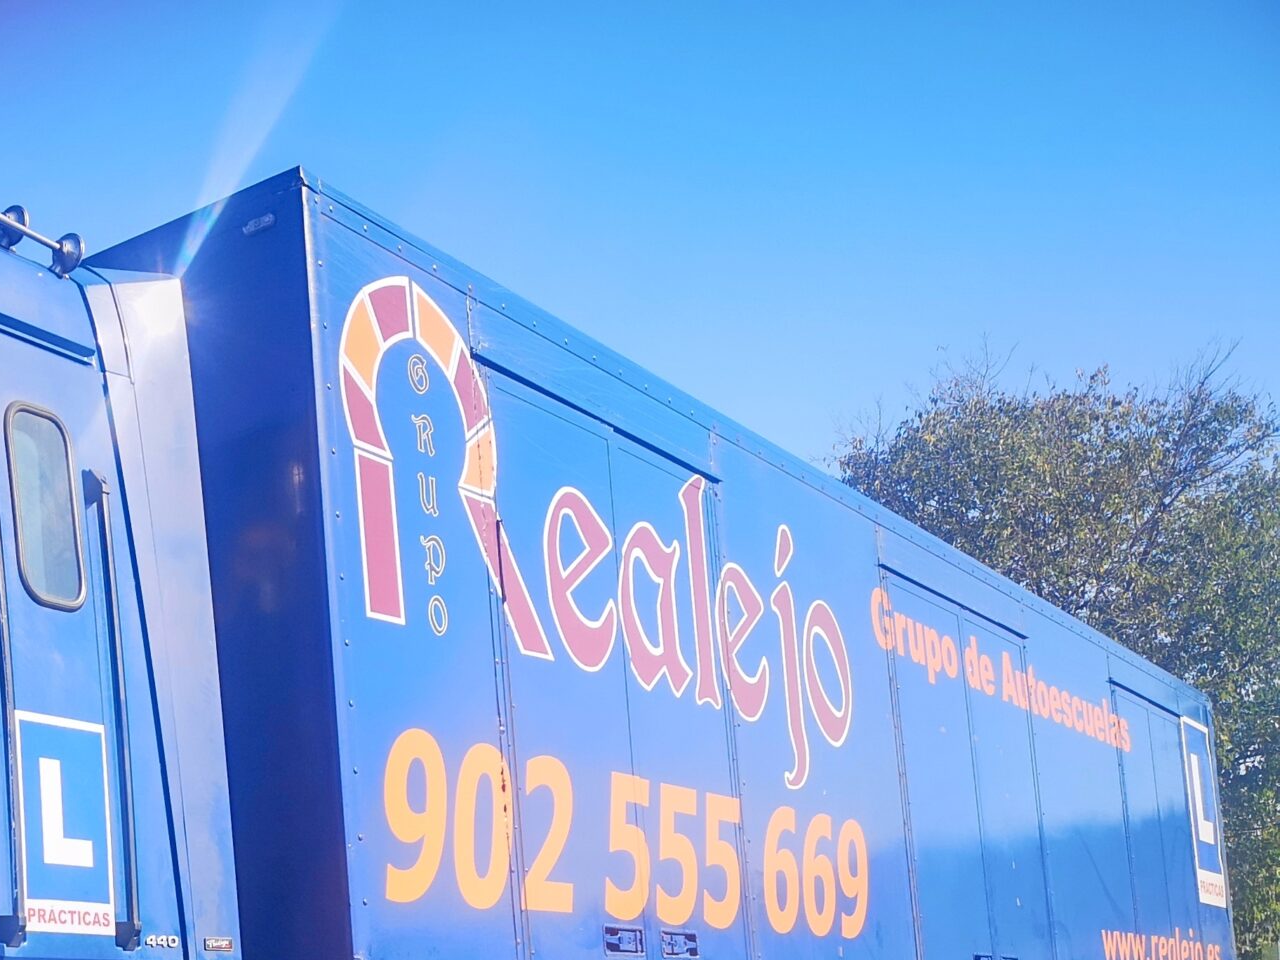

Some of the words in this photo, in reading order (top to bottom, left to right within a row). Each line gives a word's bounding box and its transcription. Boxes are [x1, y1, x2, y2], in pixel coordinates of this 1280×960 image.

[339, 275, 853, 790] Realejo
[871, 587, 958, 685] Grupo
[965, 635, 996, 696] de
[1002, 651, 1131, 753] Autoescuelas
[38, 757, 94, 868] L
[383, 728, 574, 914] 902
[605, 771, 741, 929] 555
[763, 806, 869, 939] 669
[1190, 753, 1215, 845] L
[146, 935, 179, 948] 440
